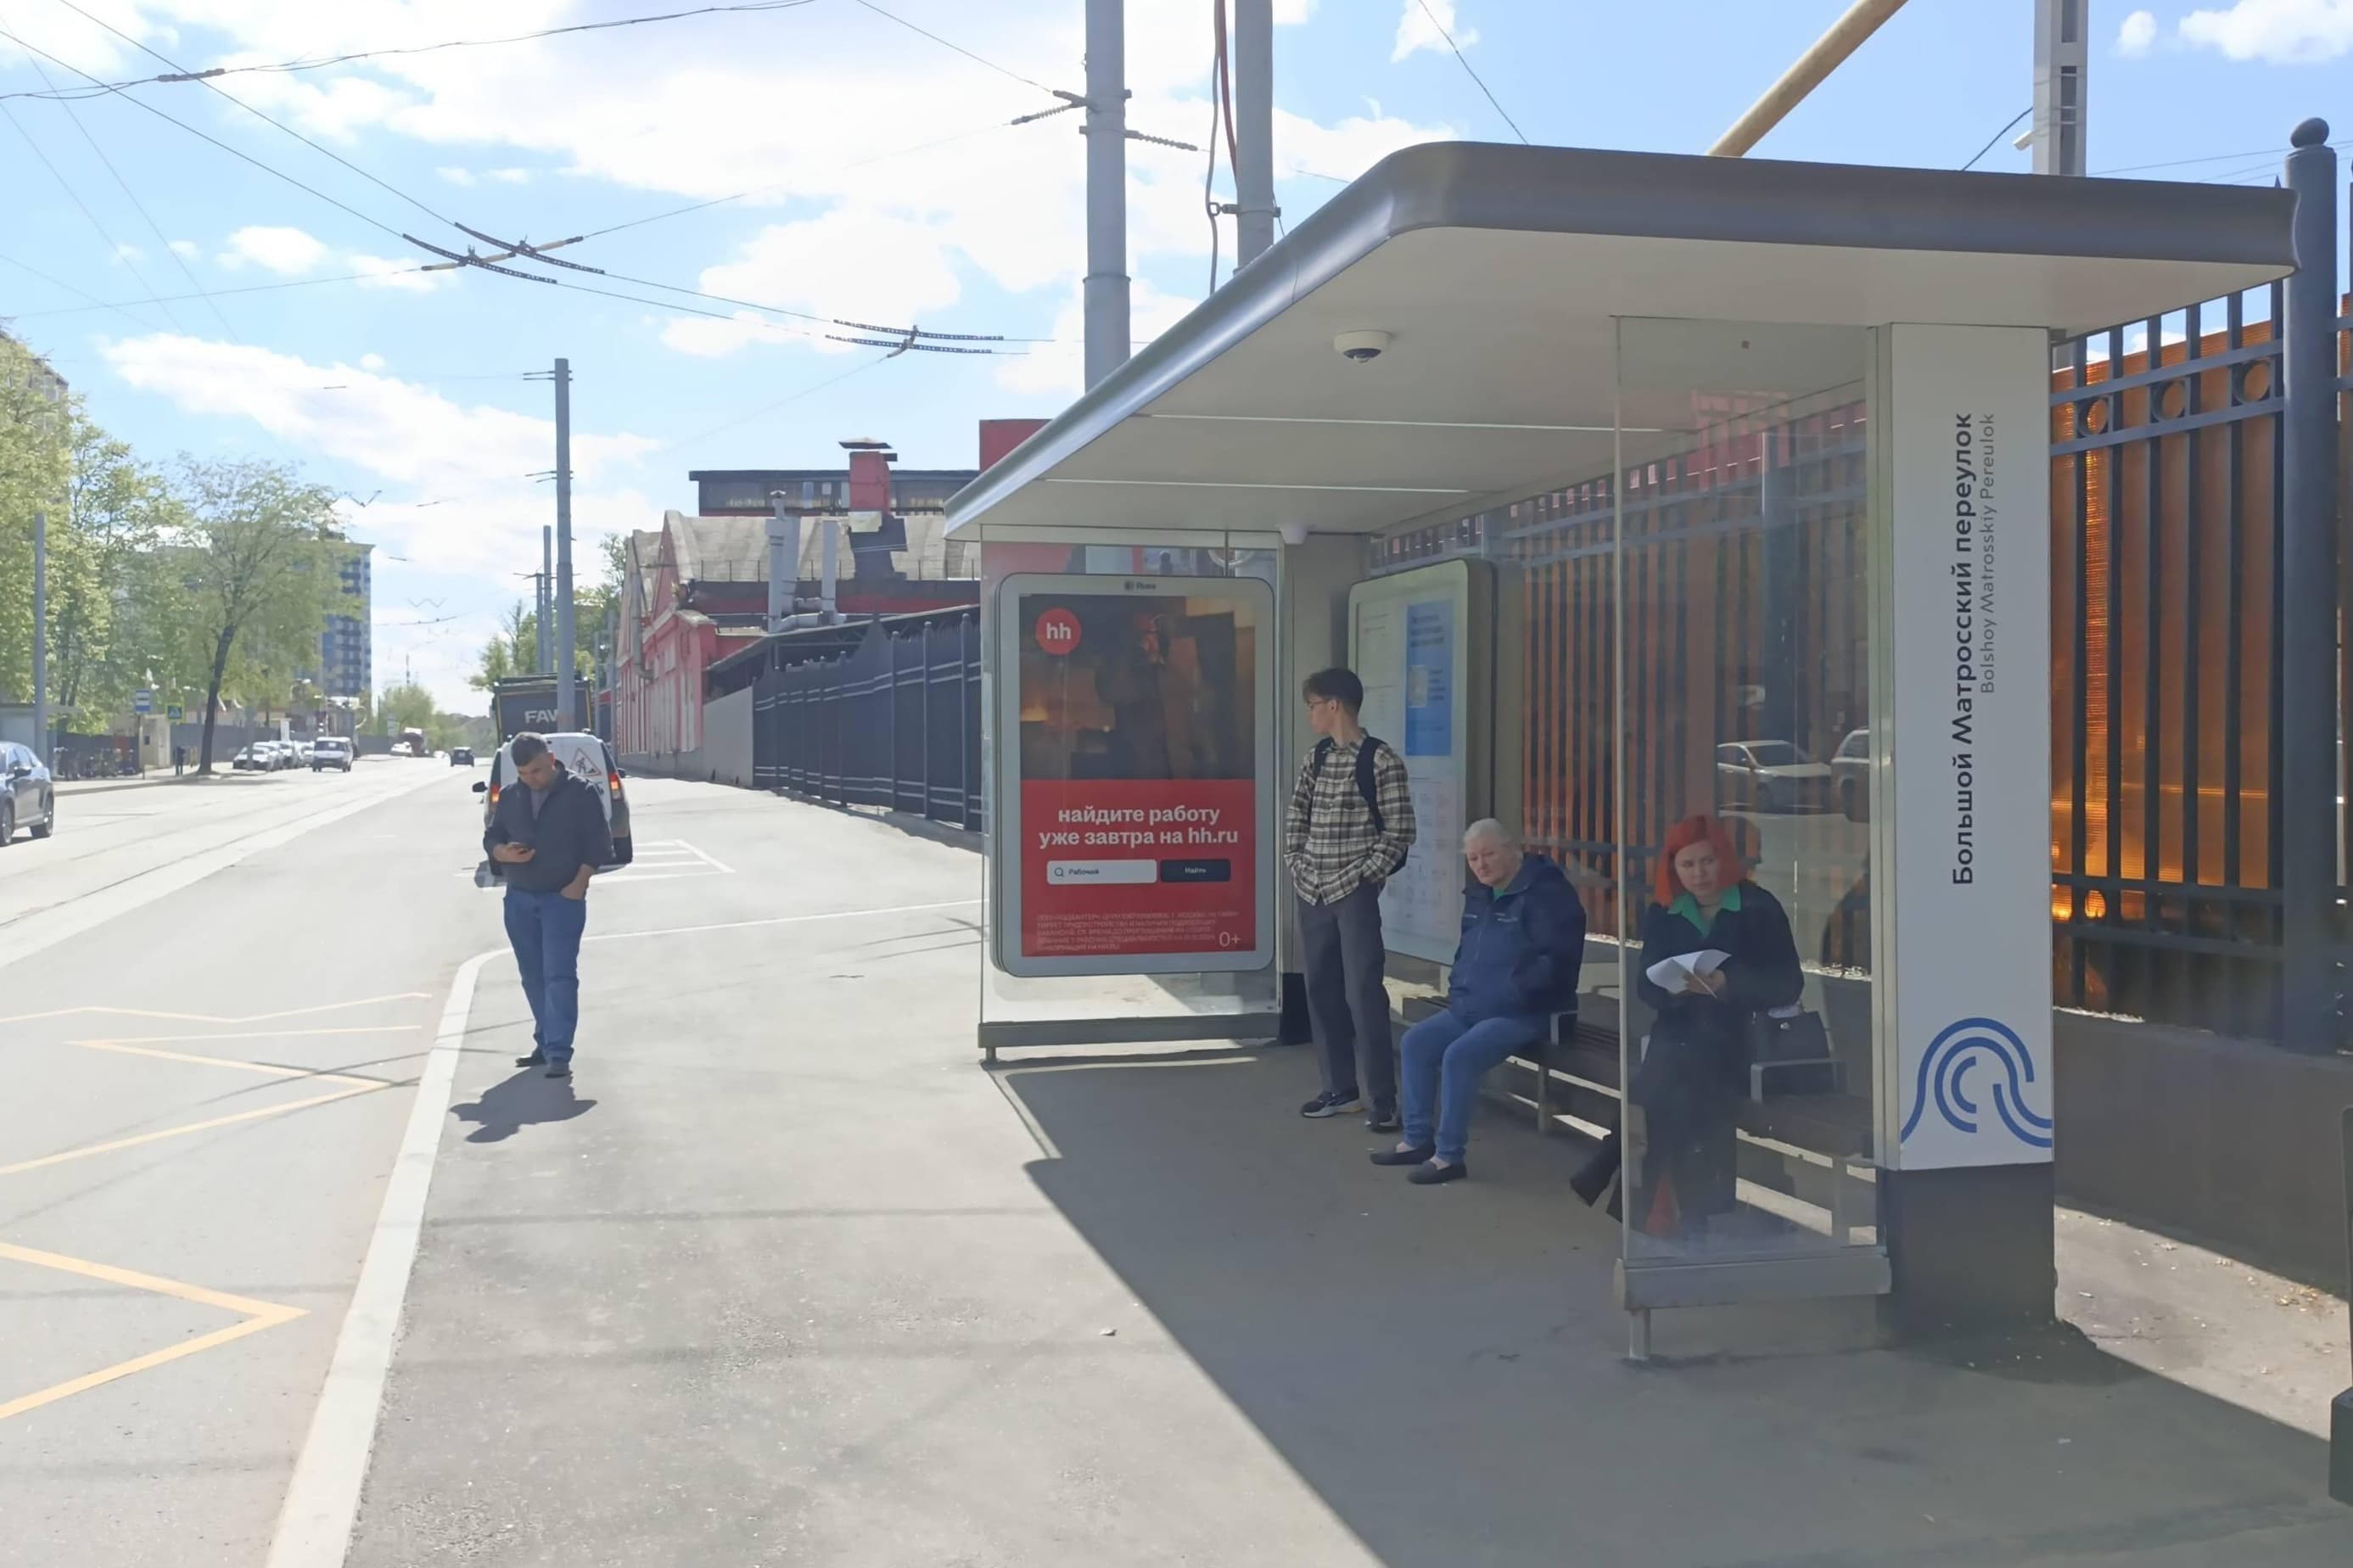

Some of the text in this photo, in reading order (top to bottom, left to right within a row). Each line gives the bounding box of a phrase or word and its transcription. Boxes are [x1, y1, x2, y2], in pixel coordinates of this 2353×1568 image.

[1979, 412, 1997, 693] Bolshoy Matrosskiy Pereulok
[1045, 622, 1072, 640] hh
[1951, 413, 1977, 884] Большой Матросский переулок
[1057, 805, 1220, 826] найдите работу
[1039, 827, 1239, 848] уже завтра на hh.ru
[1219, 931, 1241, 948] 0+
